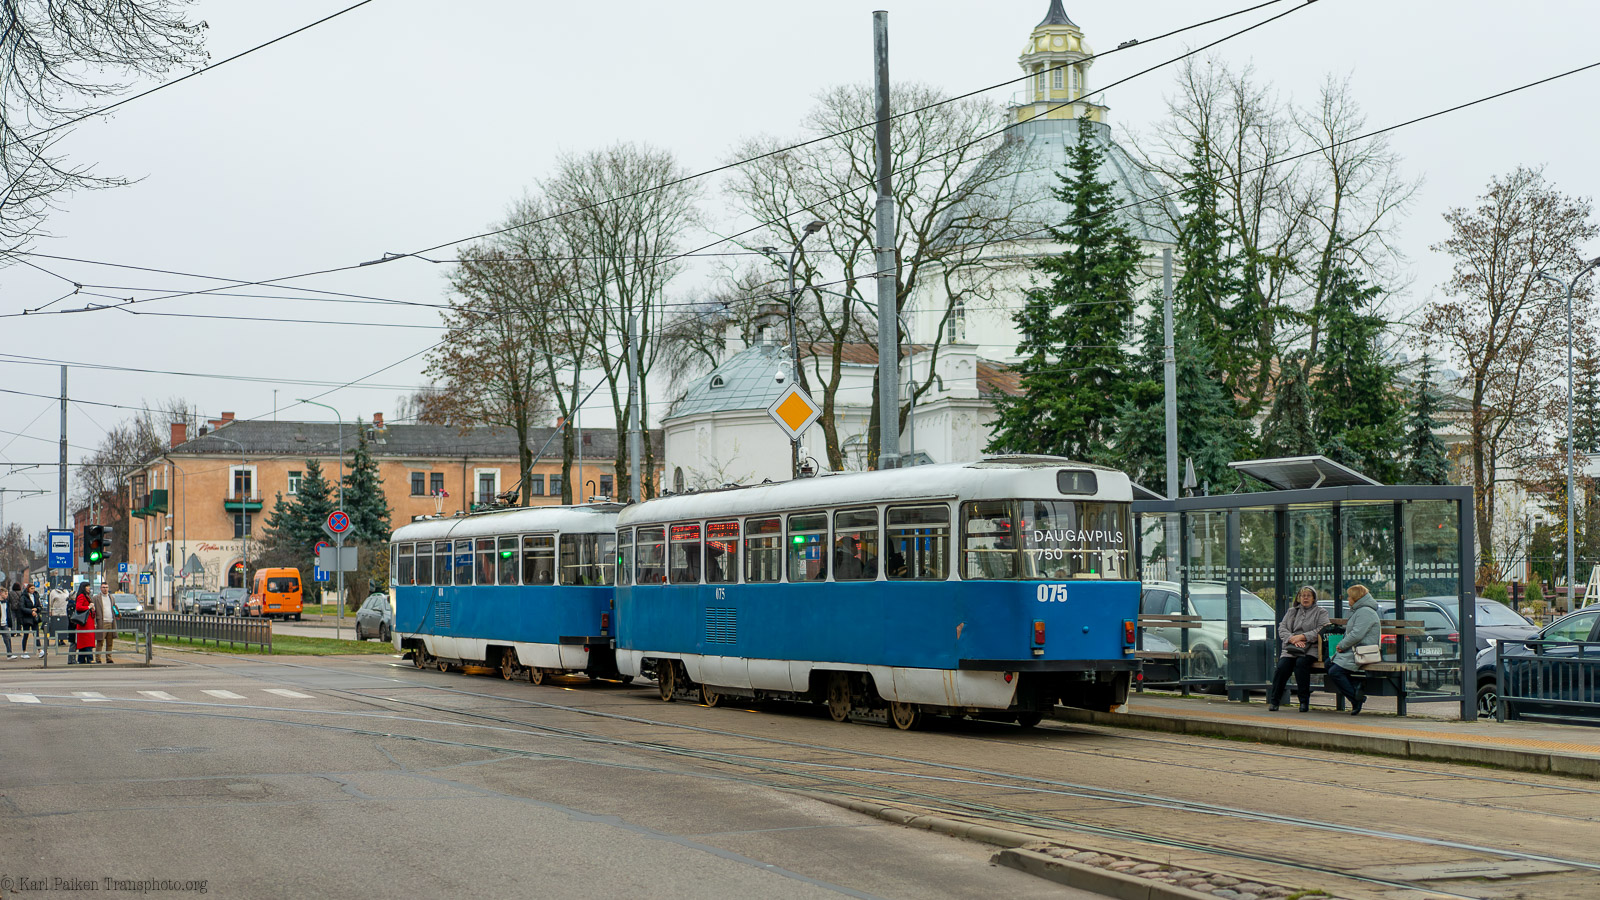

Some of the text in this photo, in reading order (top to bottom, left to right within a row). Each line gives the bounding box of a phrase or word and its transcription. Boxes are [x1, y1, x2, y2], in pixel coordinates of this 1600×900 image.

[1071, 473, 1078, 490] 1
[1033, 530, 1124, 543] DAUGAVPILS
[1036, 548, 1063, 560] 750
[1106, 555, 1116, 571] 1
[716, 588, 725, 600] 075
[1037, 584, 1068, 603] 075
